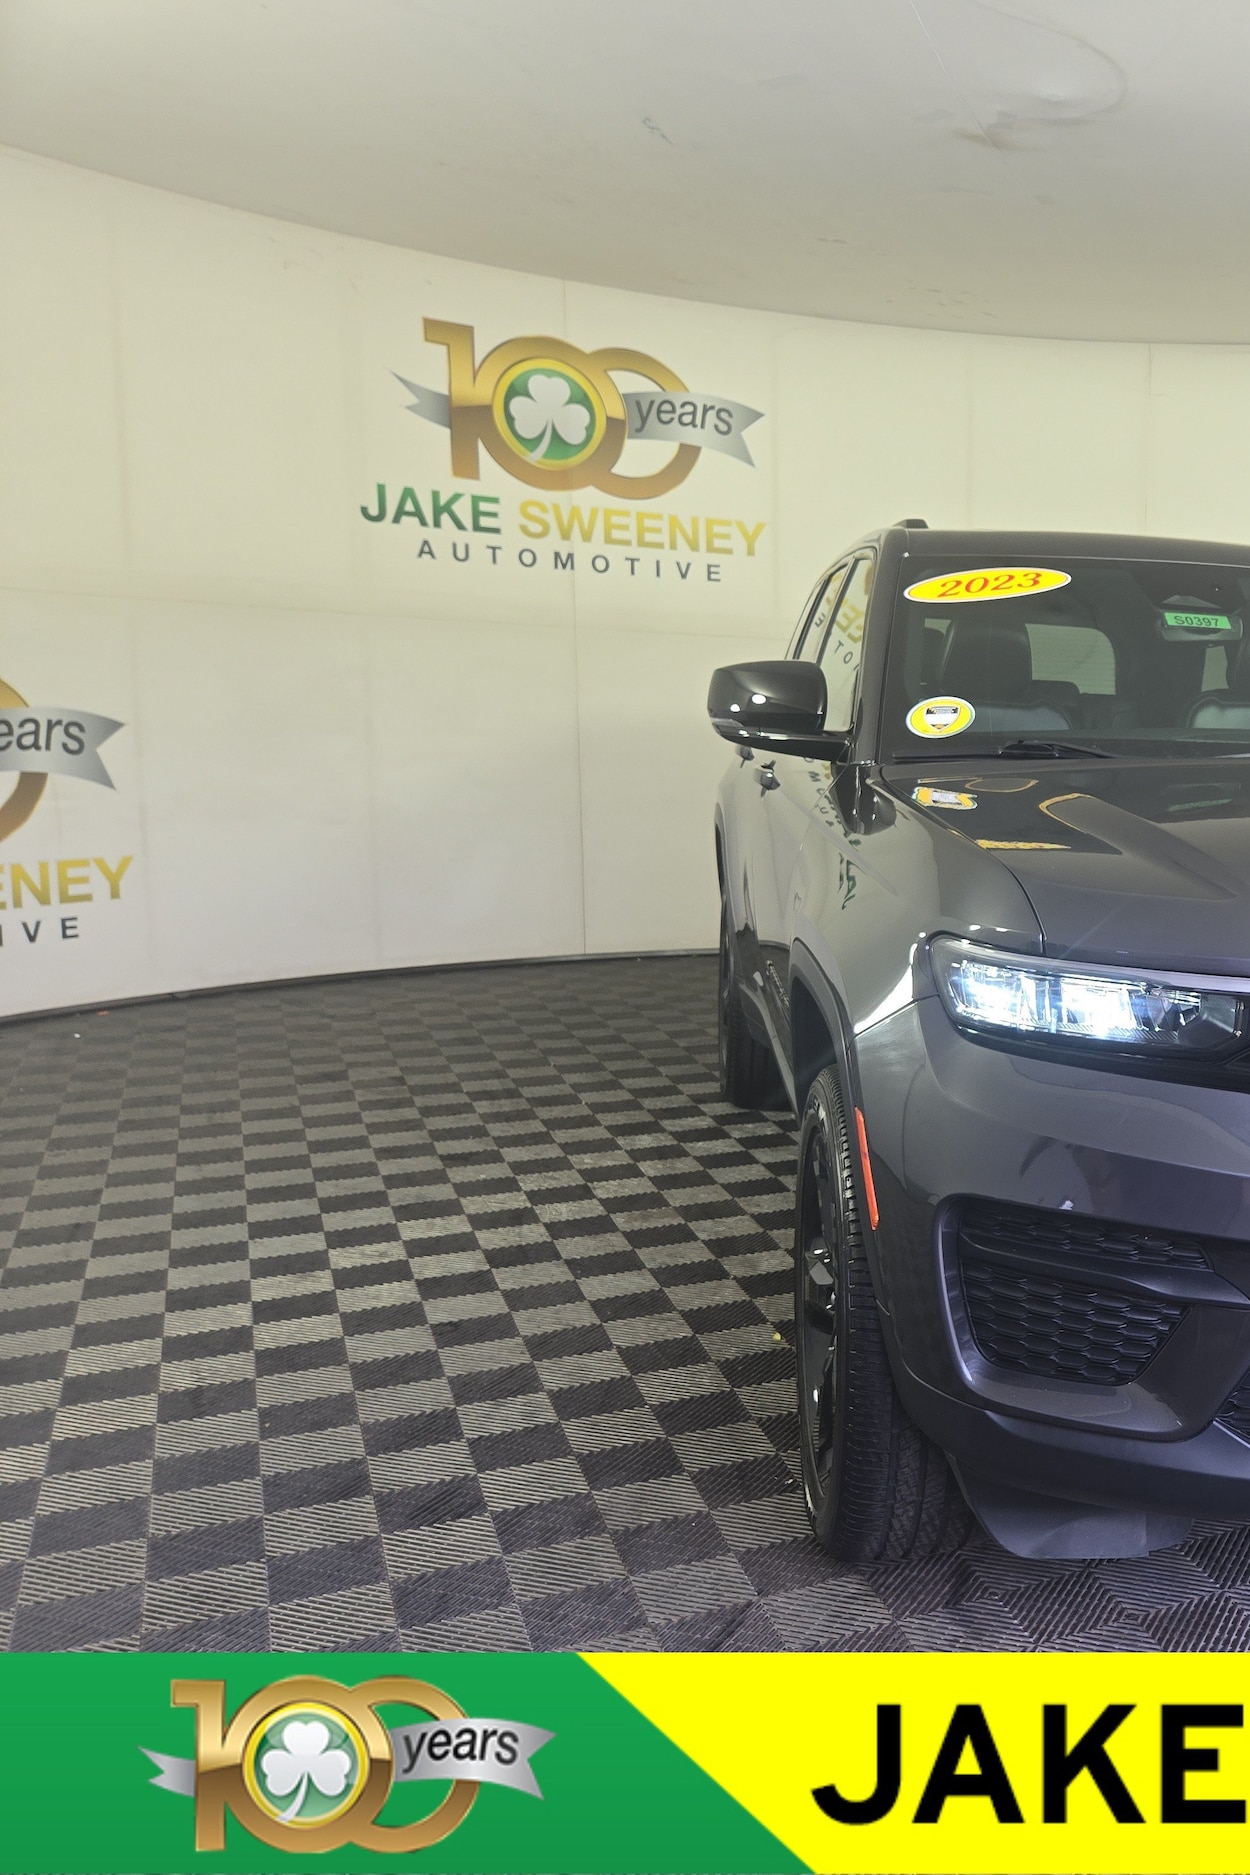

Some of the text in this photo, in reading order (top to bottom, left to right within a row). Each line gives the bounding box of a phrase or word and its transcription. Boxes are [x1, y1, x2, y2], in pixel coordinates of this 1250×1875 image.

[423, 317, 734, 500] 100 years
[360, 483, 767, 557] JAKE SWEENEY
[417, 539, 722, 582] AUTOMOTIVE
[937, 572, 1042, 598] 2023
[1174, 615, 1219, 627] S0397
[0, 717, 86, 755] ears
